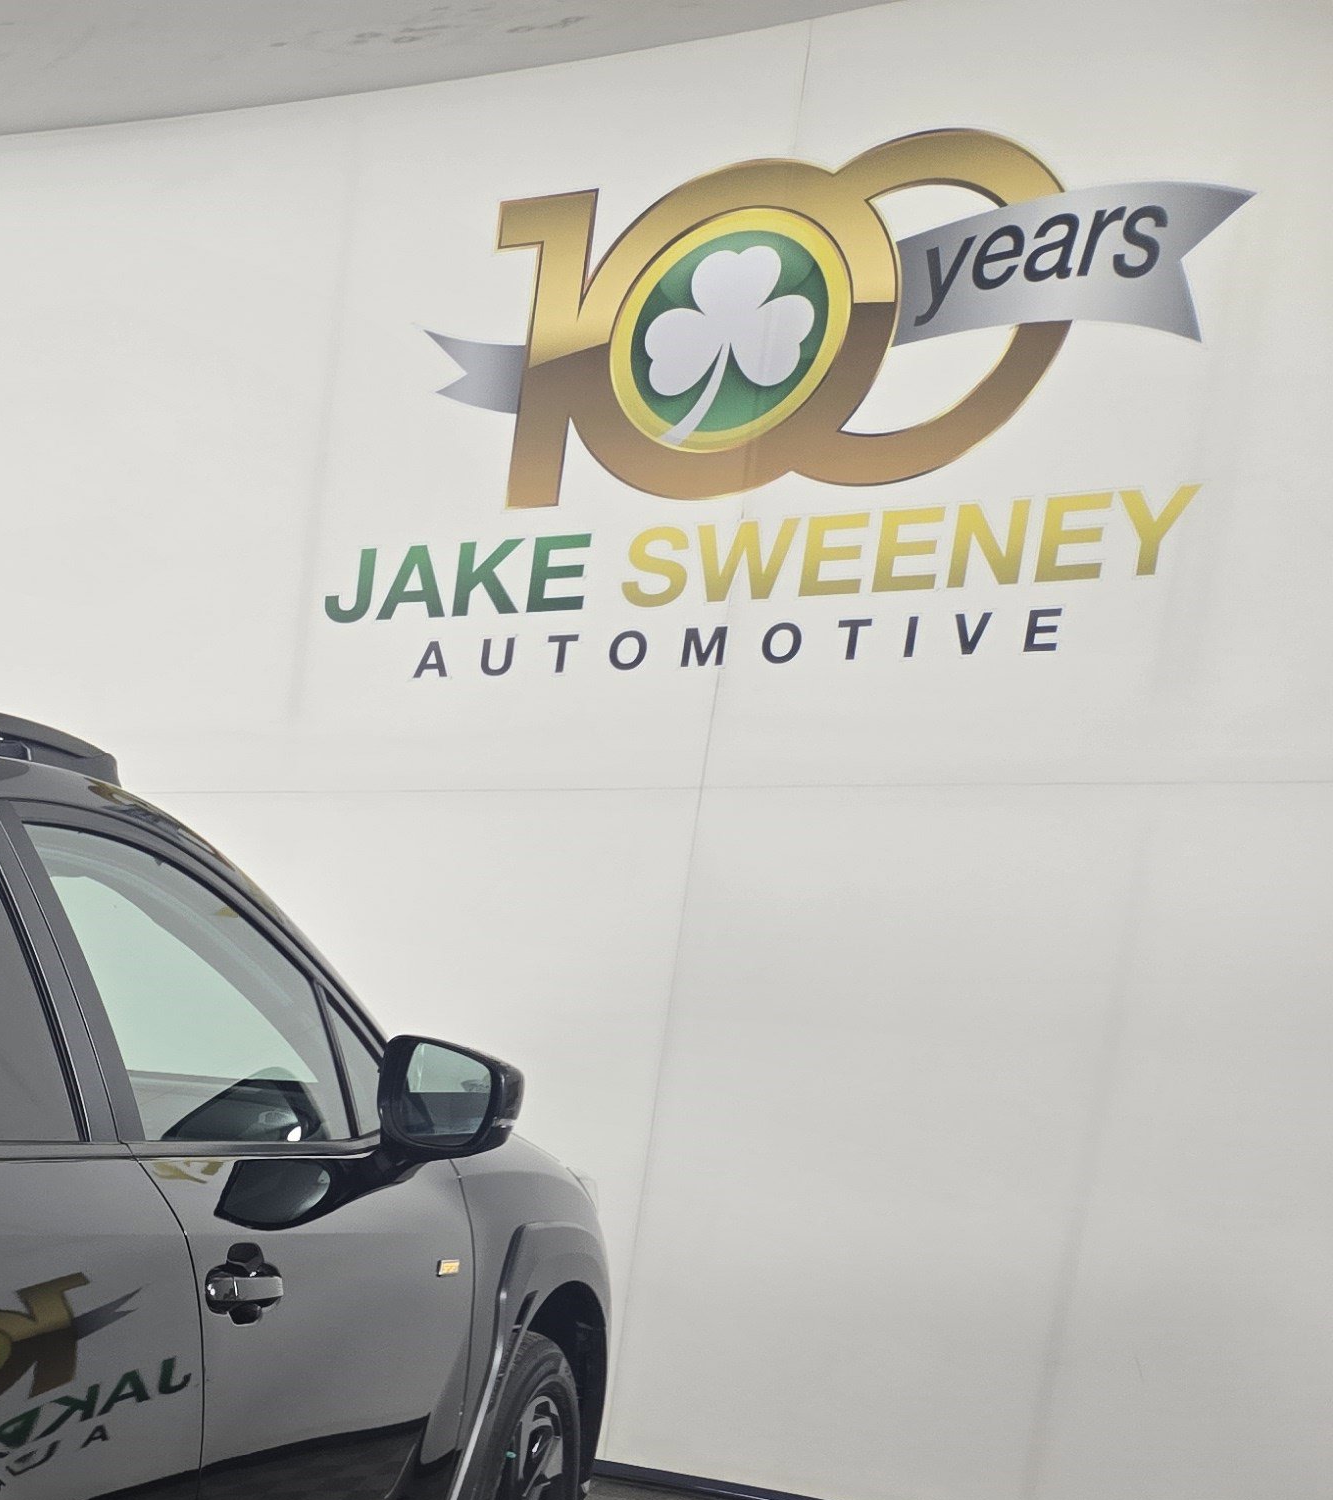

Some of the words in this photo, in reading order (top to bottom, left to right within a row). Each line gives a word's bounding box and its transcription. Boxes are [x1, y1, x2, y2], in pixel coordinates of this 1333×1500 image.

[913, 203, 1168, 328] years
[323, 532, 592, 625] JAKE
[620, 483, 1201, 609] SWEENEY
[413, 608, 1064, 681] AUTOMOTIVE
